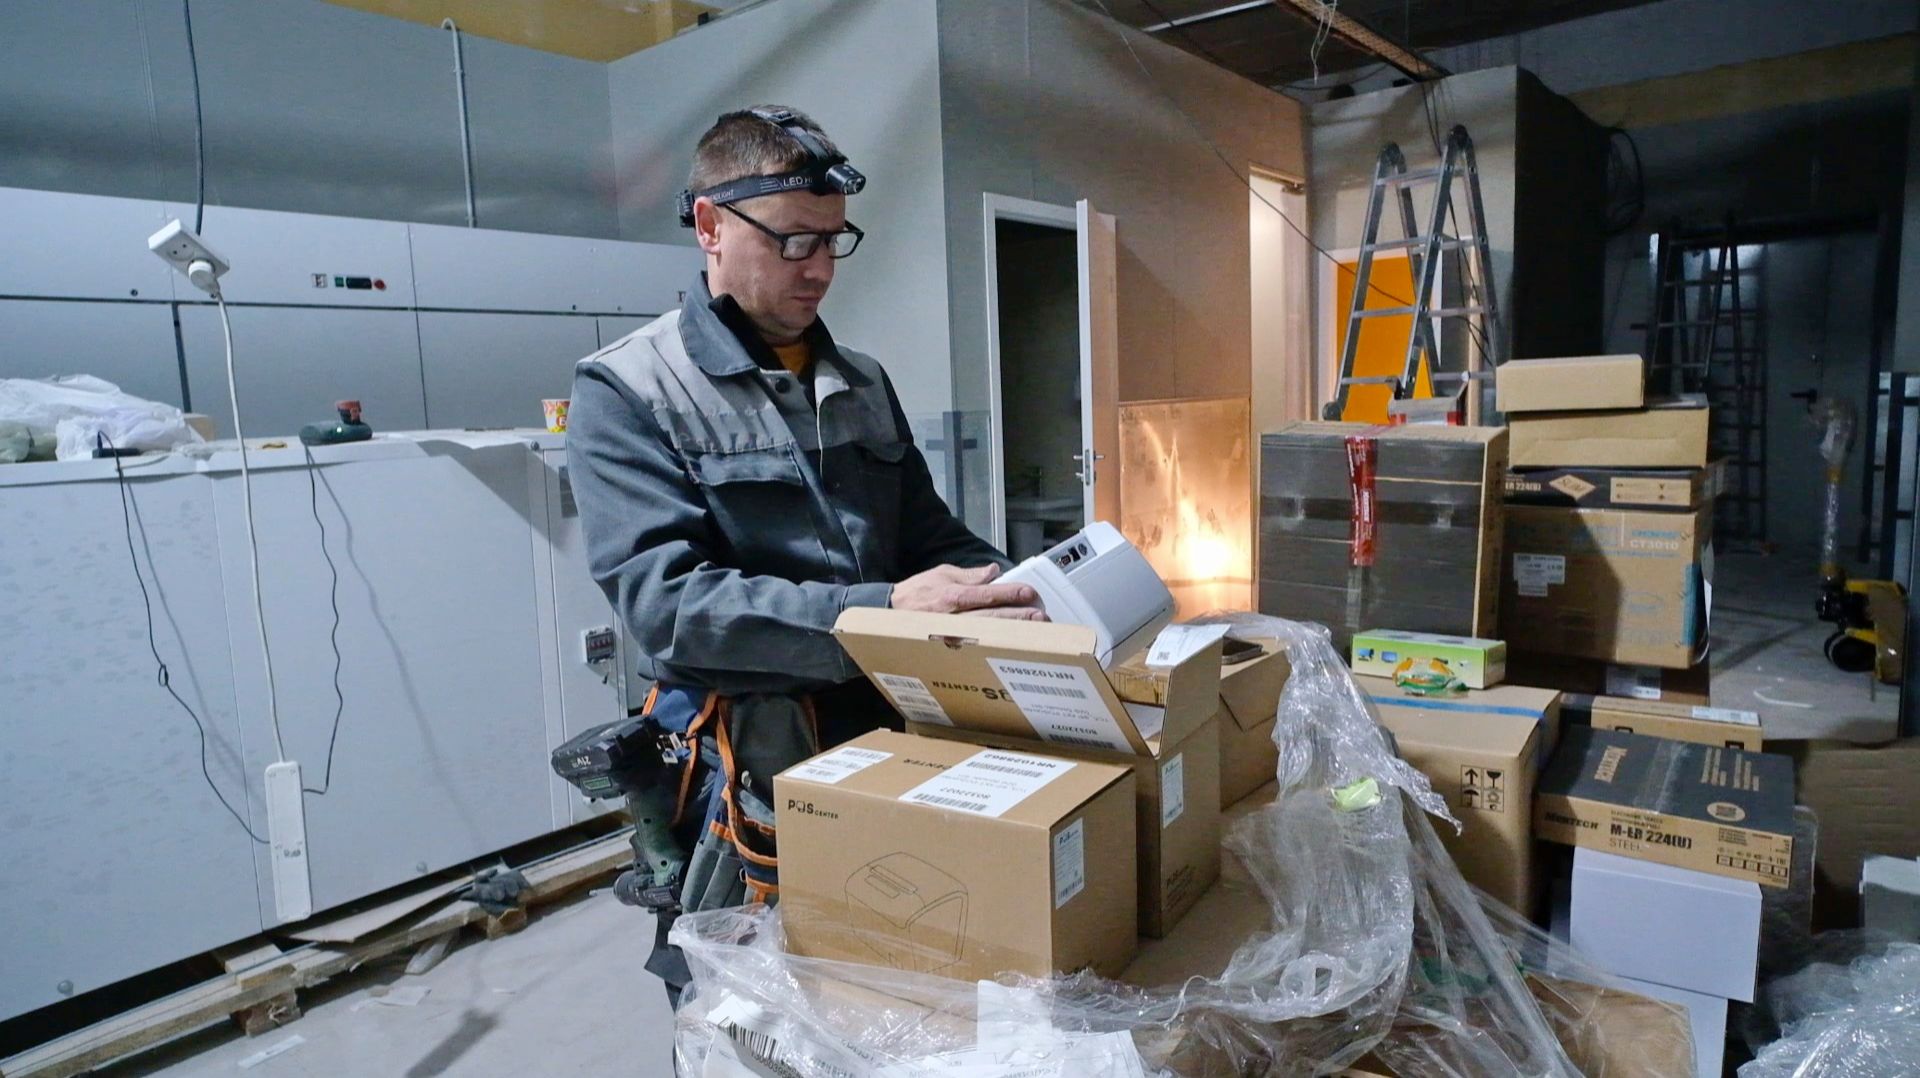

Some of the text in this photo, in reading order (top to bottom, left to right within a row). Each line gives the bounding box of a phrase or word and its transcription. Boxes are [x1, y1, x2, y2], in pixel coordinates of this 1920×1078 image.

[783, 175, 803, 187] LED
[931, 680, 979, 694] CENTER
[814, 809, 839, 821] CENTER
